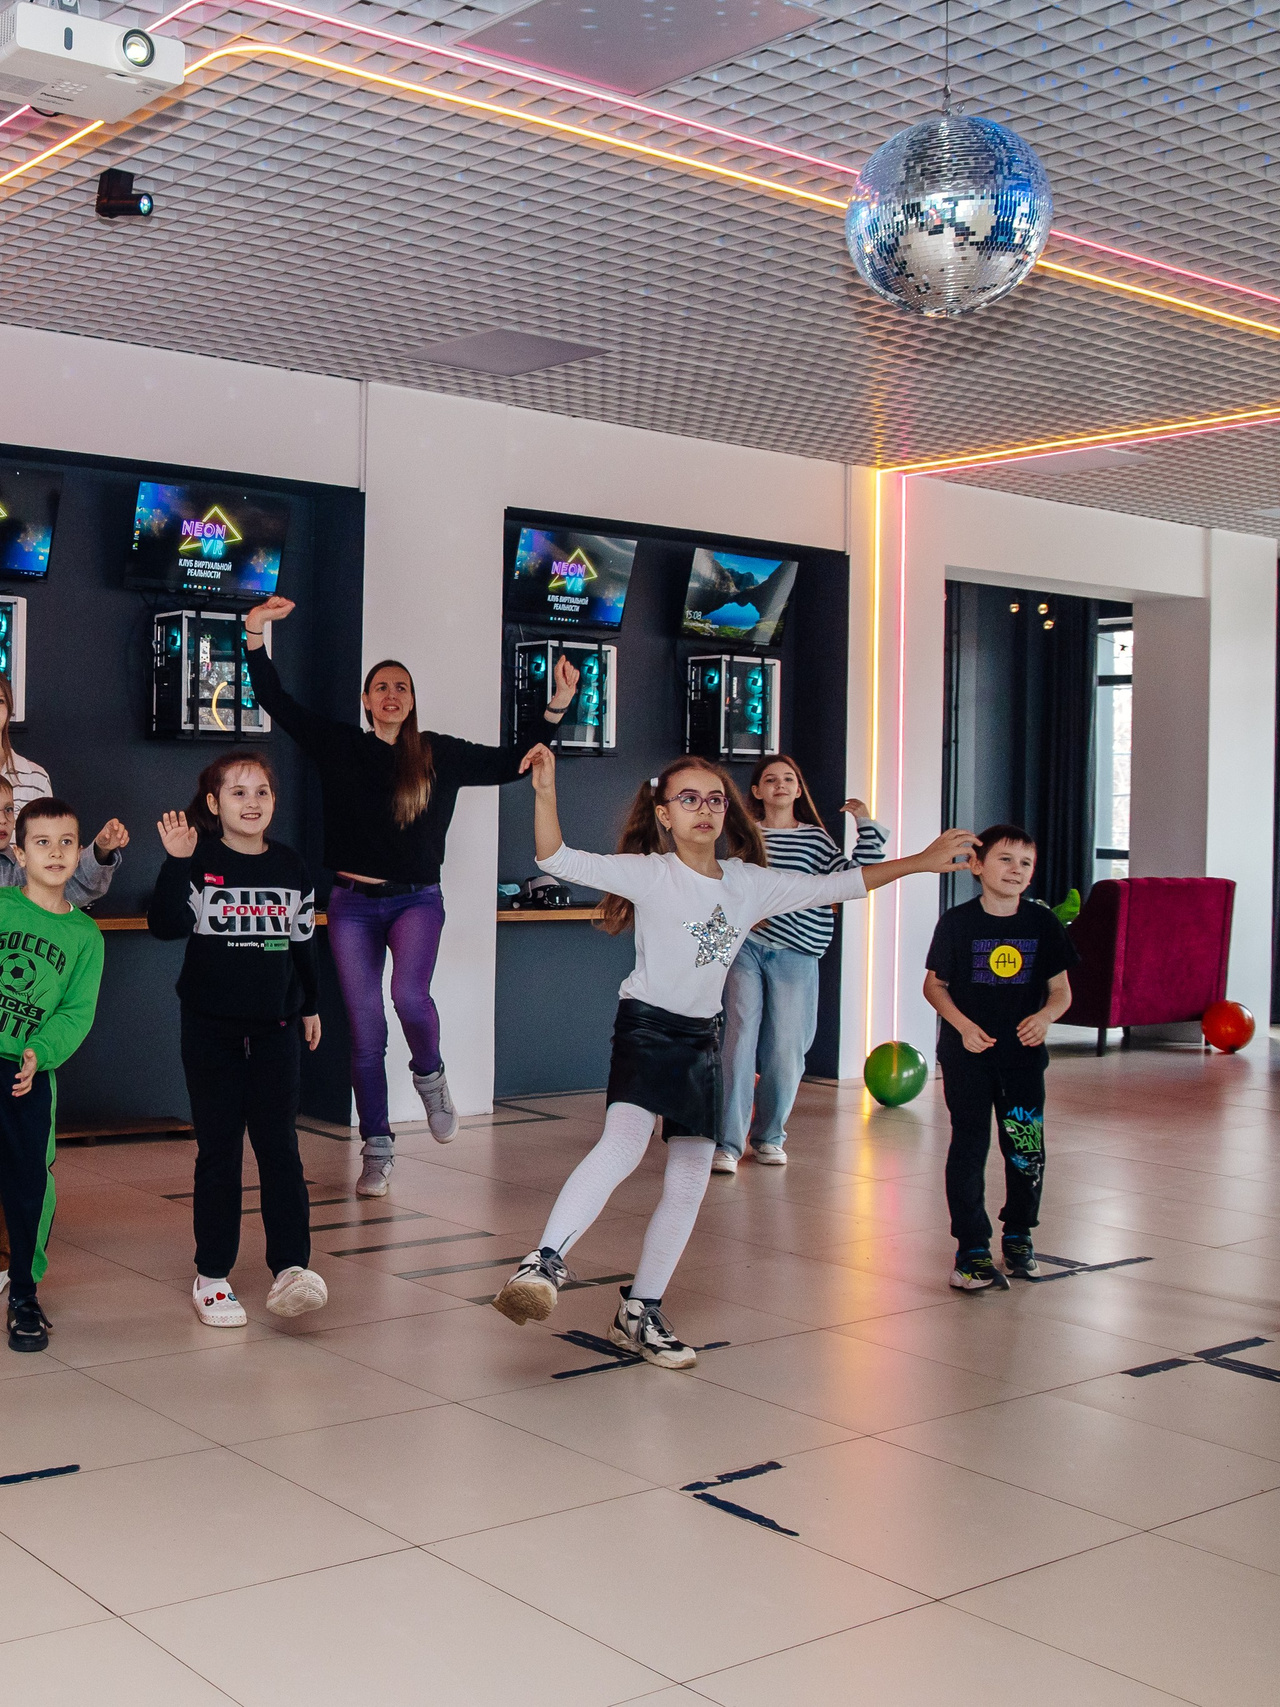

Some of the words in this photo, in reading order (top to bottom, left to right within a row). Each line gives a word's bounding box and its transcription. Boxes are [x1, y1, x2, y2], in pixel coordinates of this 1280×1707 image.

[181, 520, 227, 539] NEON
[200, 538, 225, 555] VR
[178, 558, 193, 568] КЛУБ
[194, 560, 232, 572] ВИРТУАЛЬНОЙ
[551, 561, 586, 578] NEON
[186, 568, 221, 579] РЕАЛЬНОСТИ
[565, 576, 583, 592] VR
[222, 905, 287, 917] POWER
